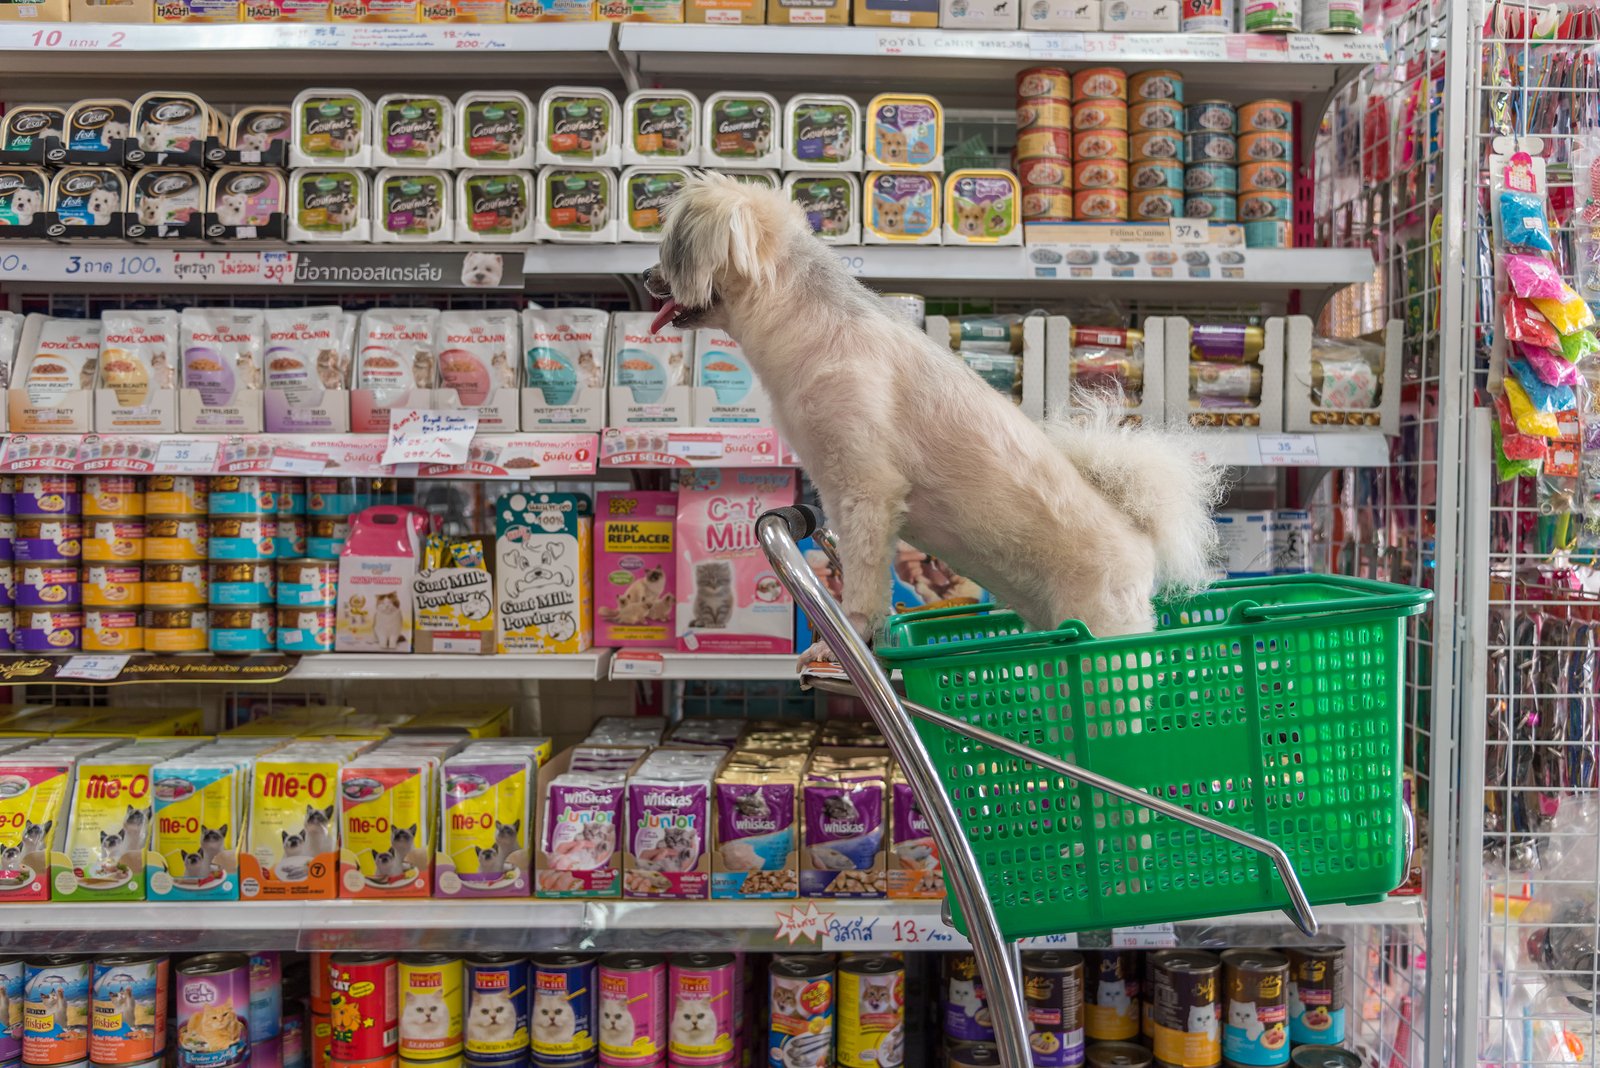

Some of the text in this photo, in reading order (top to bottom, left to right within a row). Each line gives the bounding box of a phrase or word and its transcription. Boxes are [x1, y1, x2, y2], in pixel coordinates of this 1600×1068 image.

[157, 6, 189, 17] HACHI
[247, 7, 279, 17] HACHI
[334, 6, 366, 16] HACHI
[424, 7, 456, 17] HACHI
[510, 5, 542, 15] HACHI
[600, 5, 632, 16] HACHI
[32, 30, 62, 47] 10
[107, 31, 126, 48] 2
[79, 109, 110, 125] Cesar
[17, 115, 50, 132] Cesar
[1176, 226, 1192, 238] 37
[66, 256, 82, 274] 3
[84, 262, 113, 274] ถาด
[296, 256, 442, 282] นื้อจากออสเตรเลีย
[107, 334, 165, 343] ROYAL CANIN
[192, 333, 250, 342] ROYAL CANIN
[270, 330, 330, 341] ROYAL CANIN
[369, 332, 428, 341] ROYAL CANIN
[448, 334, 506, 344] ROYAL CANIN
[534, 332, 592, 342] ROYAL CANIN
[624, 335, 682, 344] ROYAL CANIN
[41, 342, 100, 350] ROYAL CANIN
[175, 450, 190, 459] 35
[612, 454, 676, 464] BEST SELLER
[11, 460, 75, 470] BEST SELLER
[84, 460, 148, 470] BEST SELLER
[428, 464, 493, 474] BEST SELLER
[538, 516, 563, 524] 100%
[608, 524, 639, 532] MILK
[608, 534, 670, 543] REPLACER
[706, 524, 760, 550] Mil
[414, 571, 488, 594] Goat Milk
[416, 590, 470, 610] Powder
[501, 591, 574, 615] Goat Milk
[504, 612, 556, 631] Powder
[0, 812, 24, 828] e-O
[558, 806, 616, 825] Junior
[638, 810, 697, 830] Junior
[736, 818, 776, 830] whiskas
[824, 822, 864, 834] whiskas
[829, 916, 880, 942] วิสกัส
[25, 1016, 52, 1030] friskies
[94, 1016, 120, 1029] friskies
